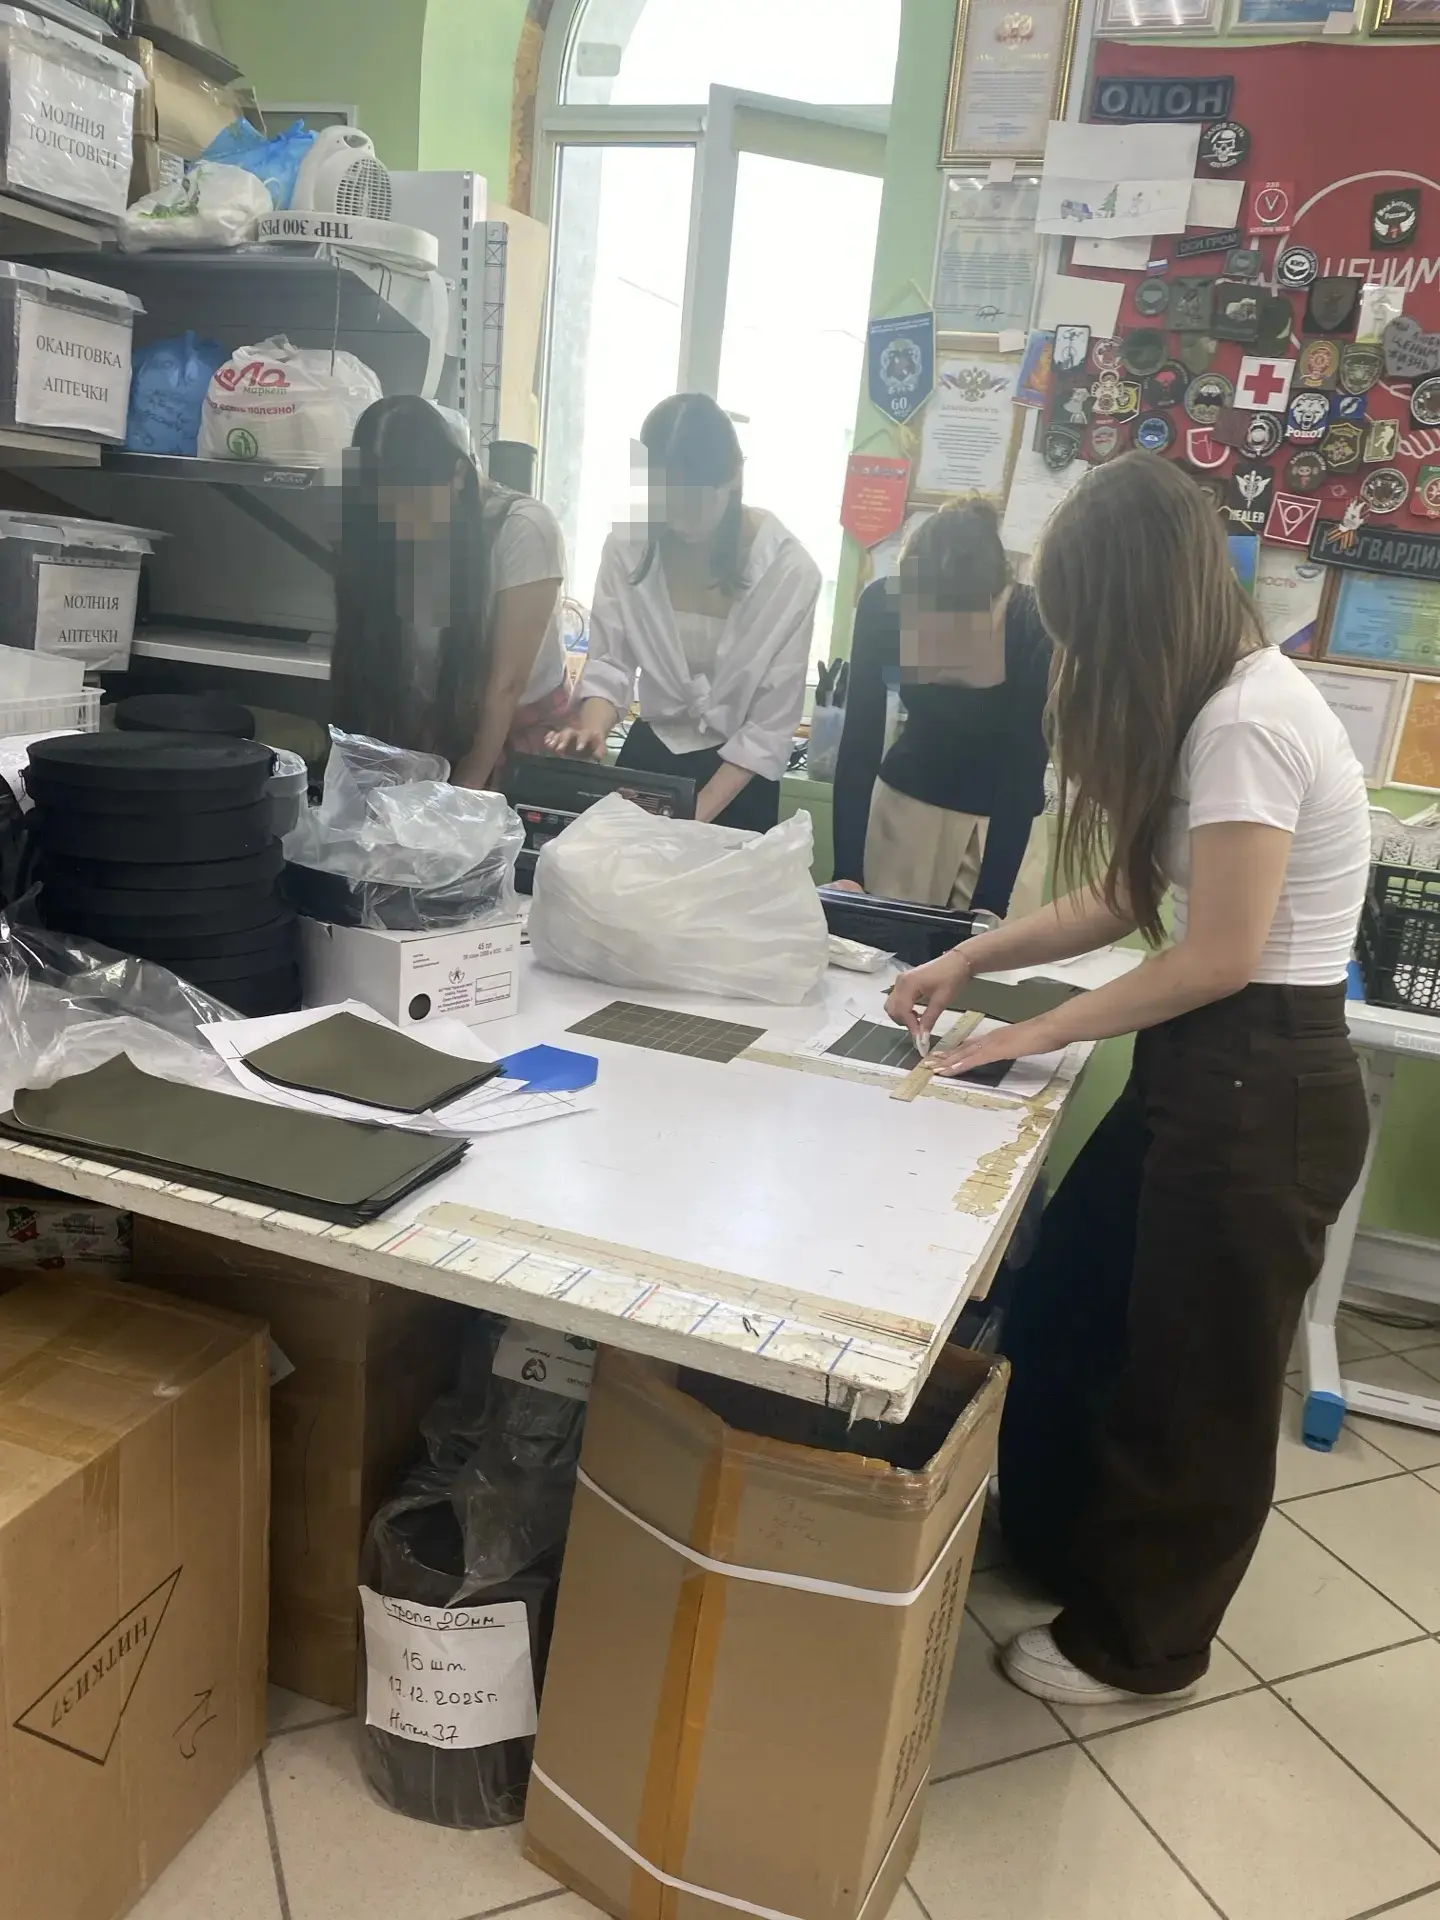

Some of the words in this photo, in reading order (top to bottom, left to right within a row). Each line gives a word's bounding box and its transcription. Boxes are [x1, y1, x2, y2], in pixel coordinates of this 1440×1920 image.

[1099, 84, 1225, 115] ОМОН
[40, 101, 106, 140] МОЛНИЯ
[28, 123, 119, 170] ТОЛСТОВКИ
[283, 218, 309, 236] 300
[36, 334, 122, 369] ОКАНТОВКА
[42, 377, 109, 403] АПТЕЧКИ
[890, 396, 908, 411] 60
[1229, 509, 1265, 524] HEALER
[63, 595, 119, 611] МОЛНИЯ
[58, 628, 118, 644] АПТЕЧКИ
[382, 1594, 432, 1626] Стропа
[436, 1611, 495, 1630] 20мм
[402, 1648, 424, 1671] 15
[431, 1659, 466, 1672] шт.
